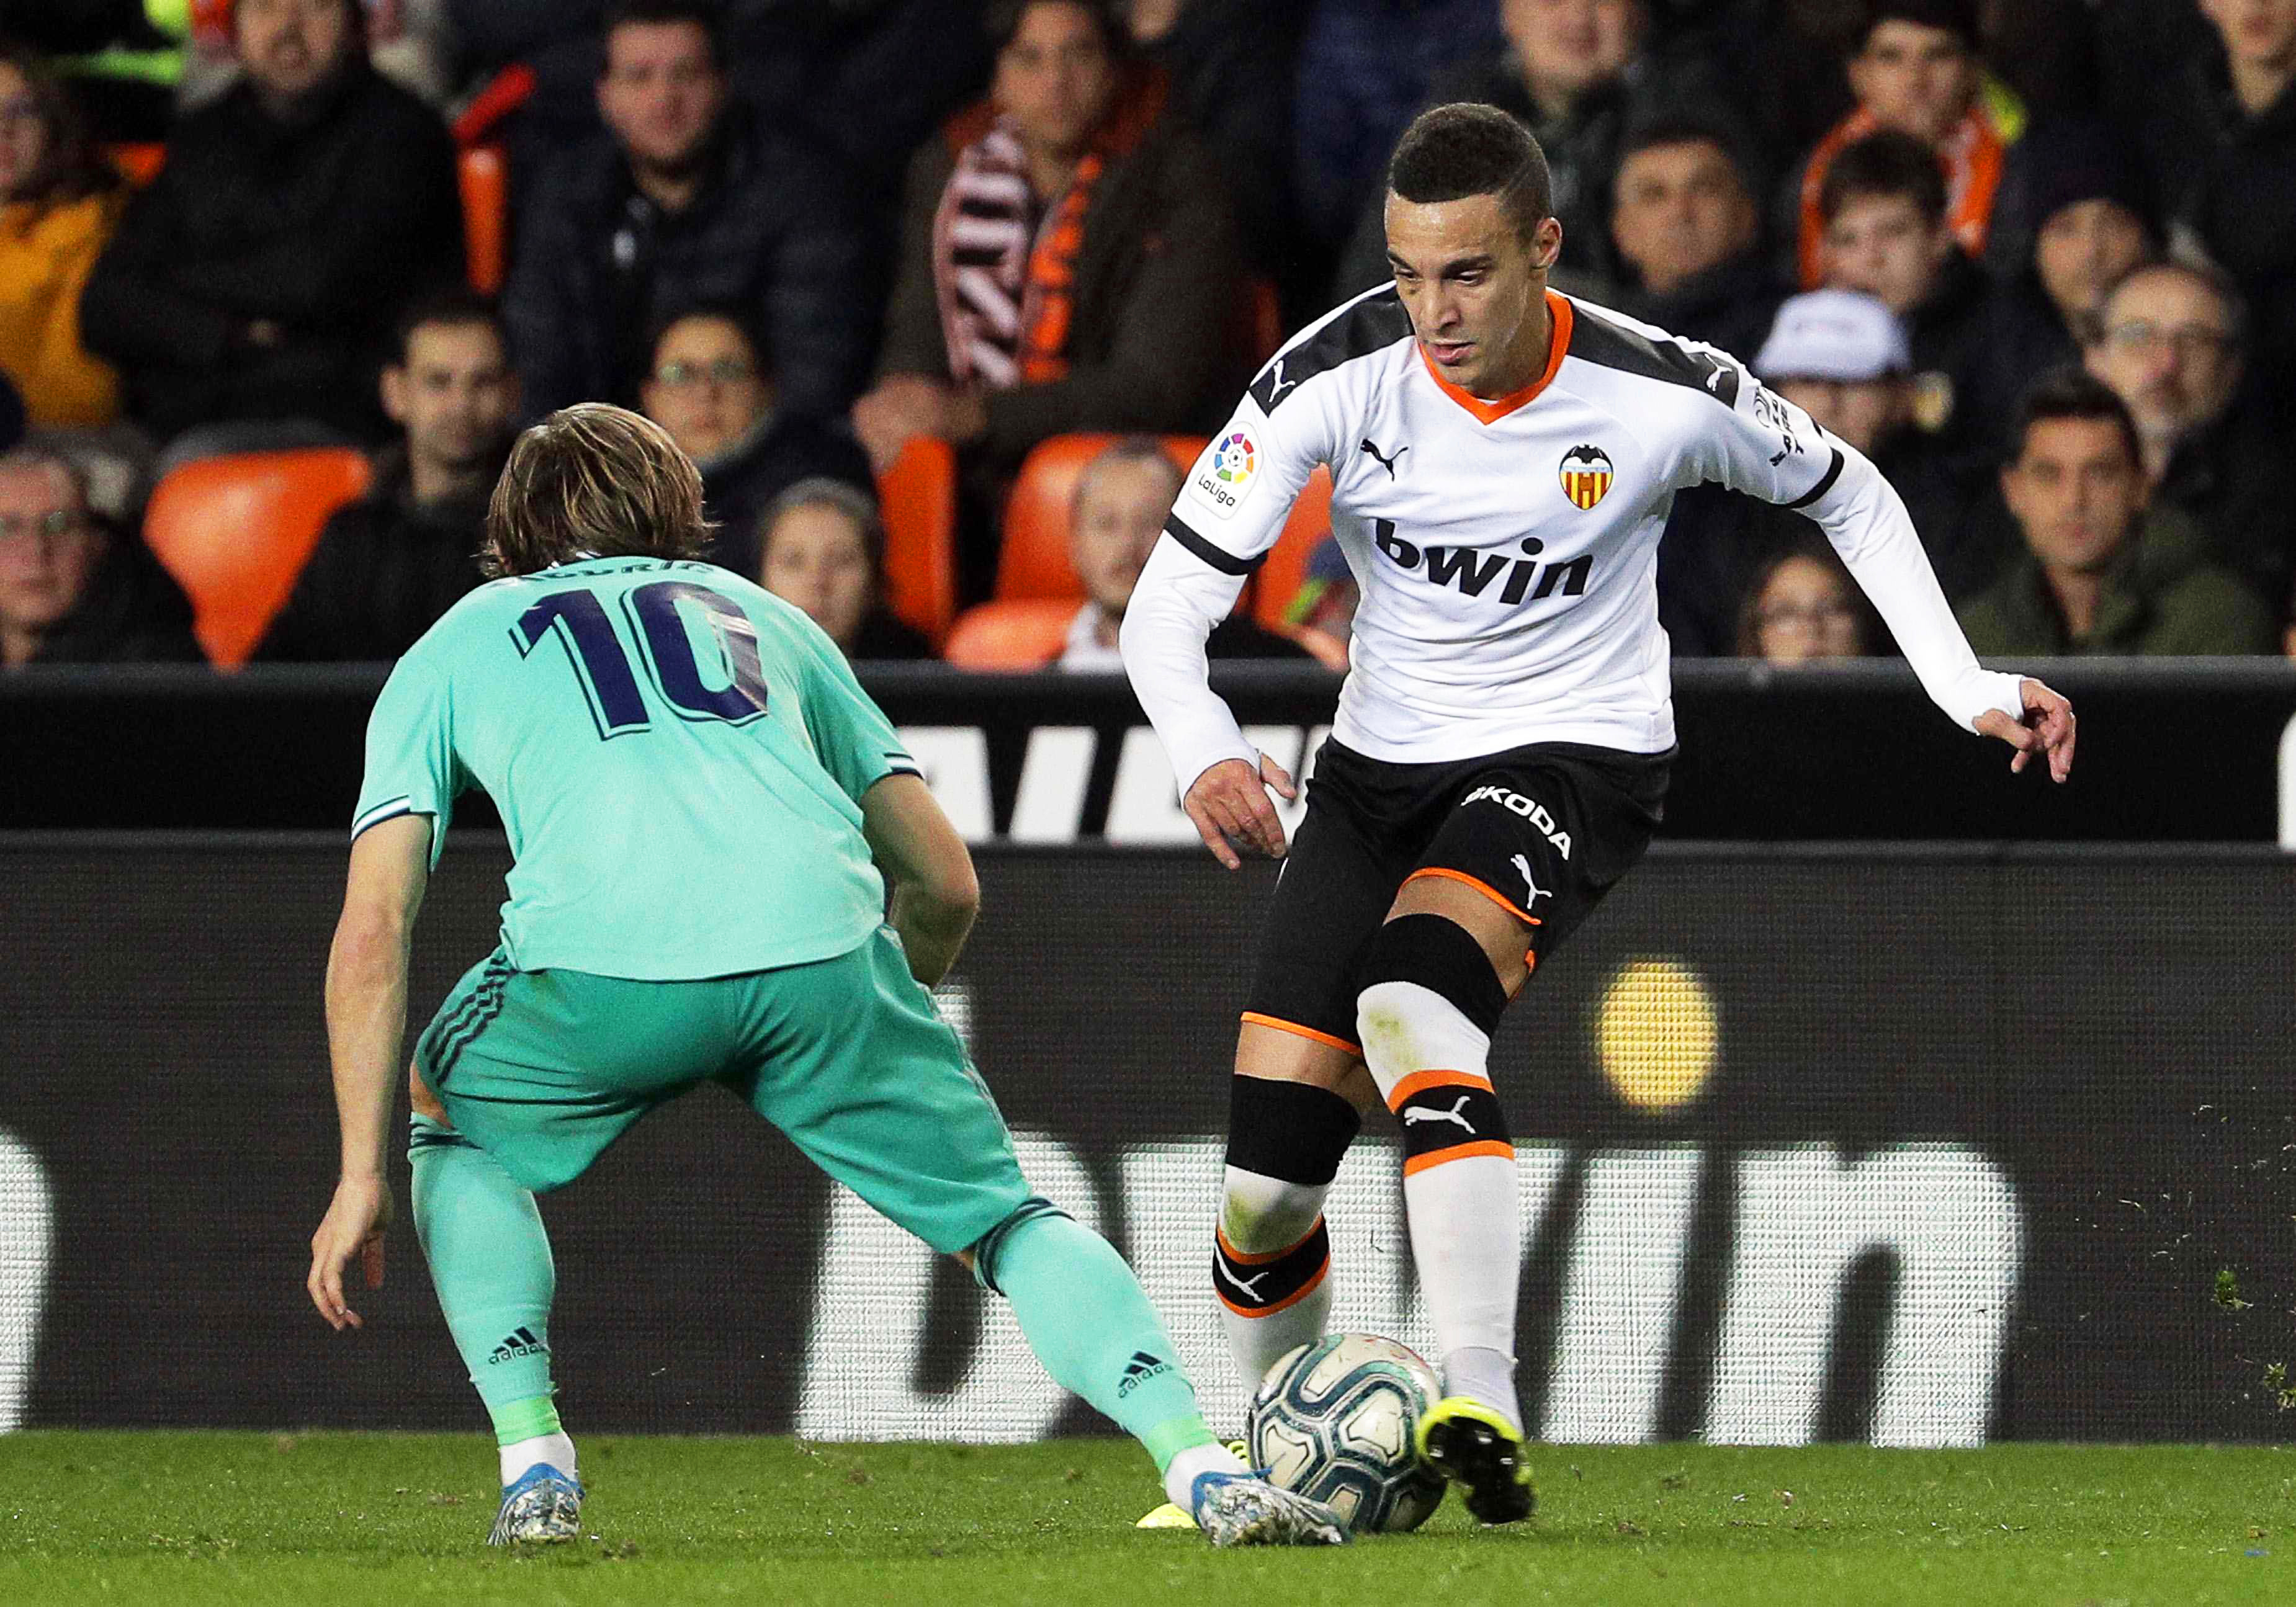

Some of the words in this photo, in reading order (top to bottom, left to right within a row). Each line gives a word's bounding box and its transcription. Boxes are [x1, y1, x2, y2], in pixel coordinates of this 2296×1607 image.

[1198, 473, 1236, 506] LaLiga
[1376, 518, 1594, 605] bwin
[508, 581, 768, 741] 10
[1118, 1364, 1173, 1399] adidas
